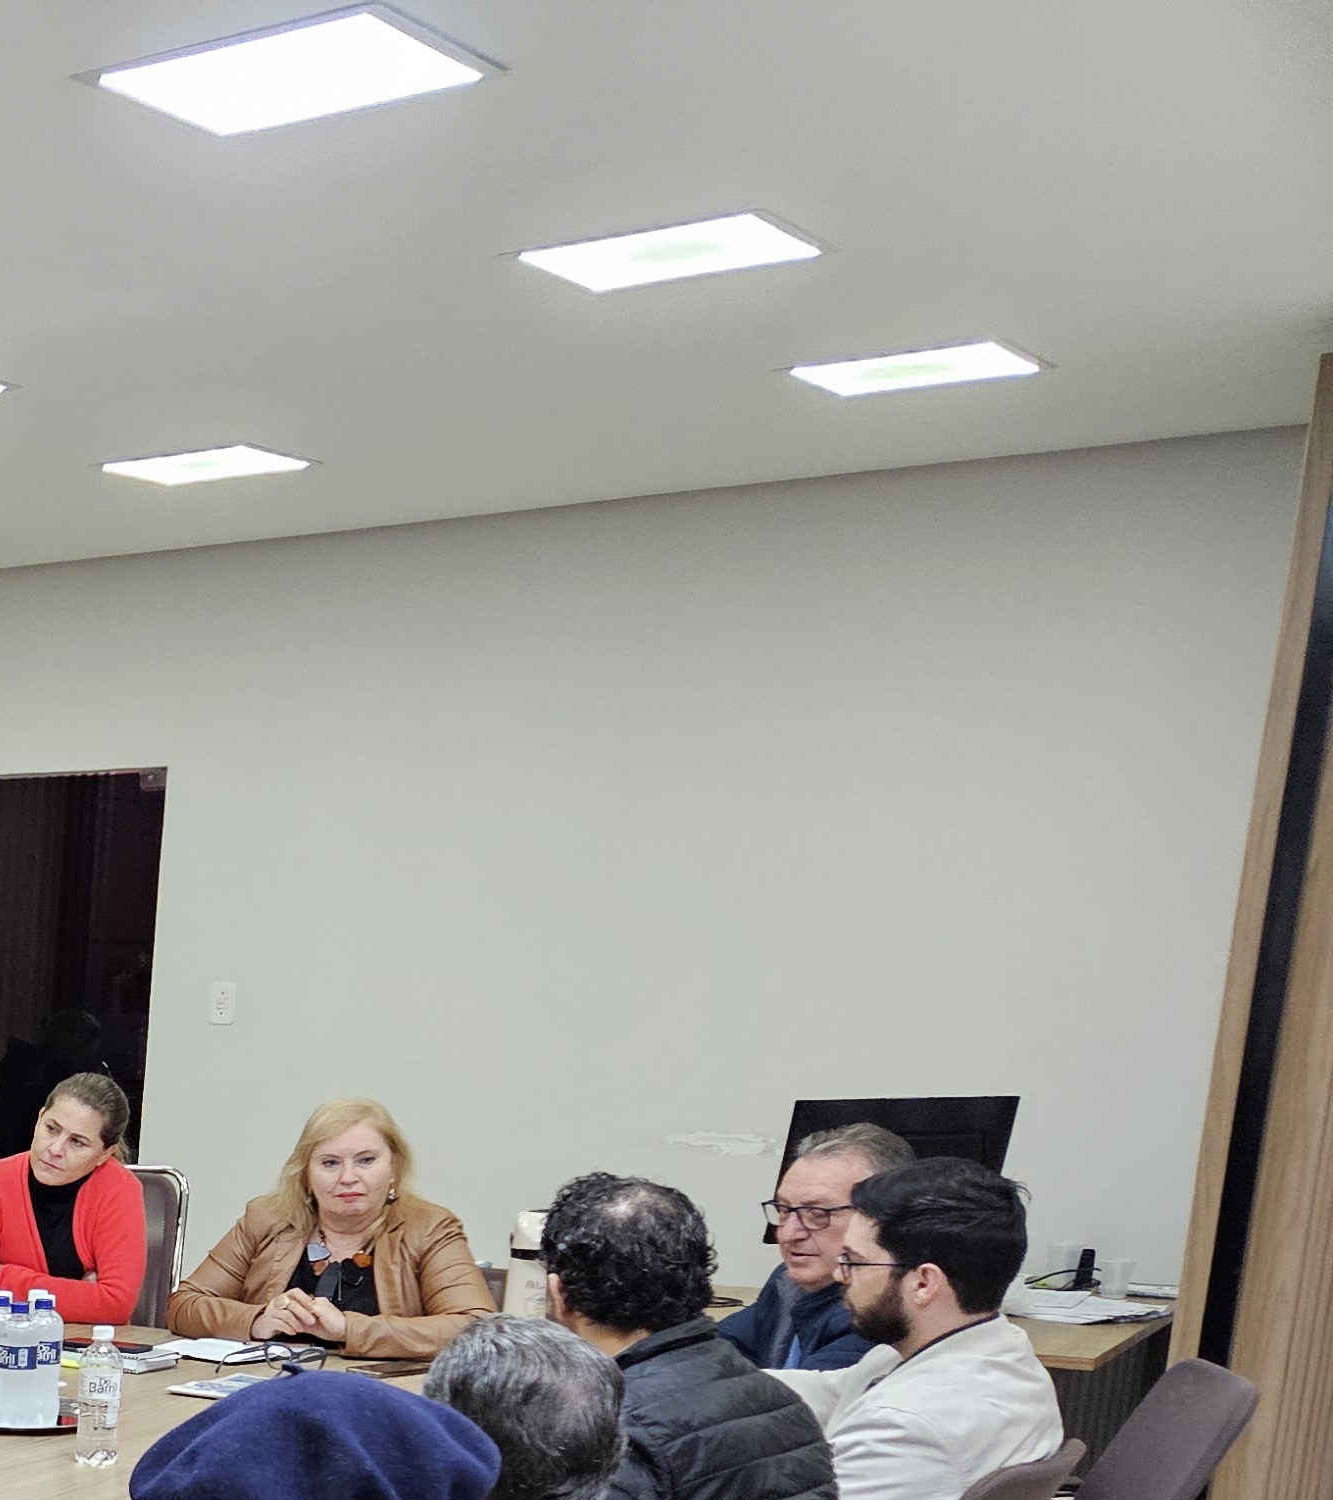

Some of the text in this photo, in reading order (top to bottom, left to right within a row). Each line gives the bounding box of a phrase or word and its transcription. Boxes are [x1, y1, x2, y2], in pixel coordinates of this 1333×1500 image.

[36, 1348, 57, 1362] arril
[99, 1377, 111, 1386] Do
[89, 1382, 119, 1394] Barril
